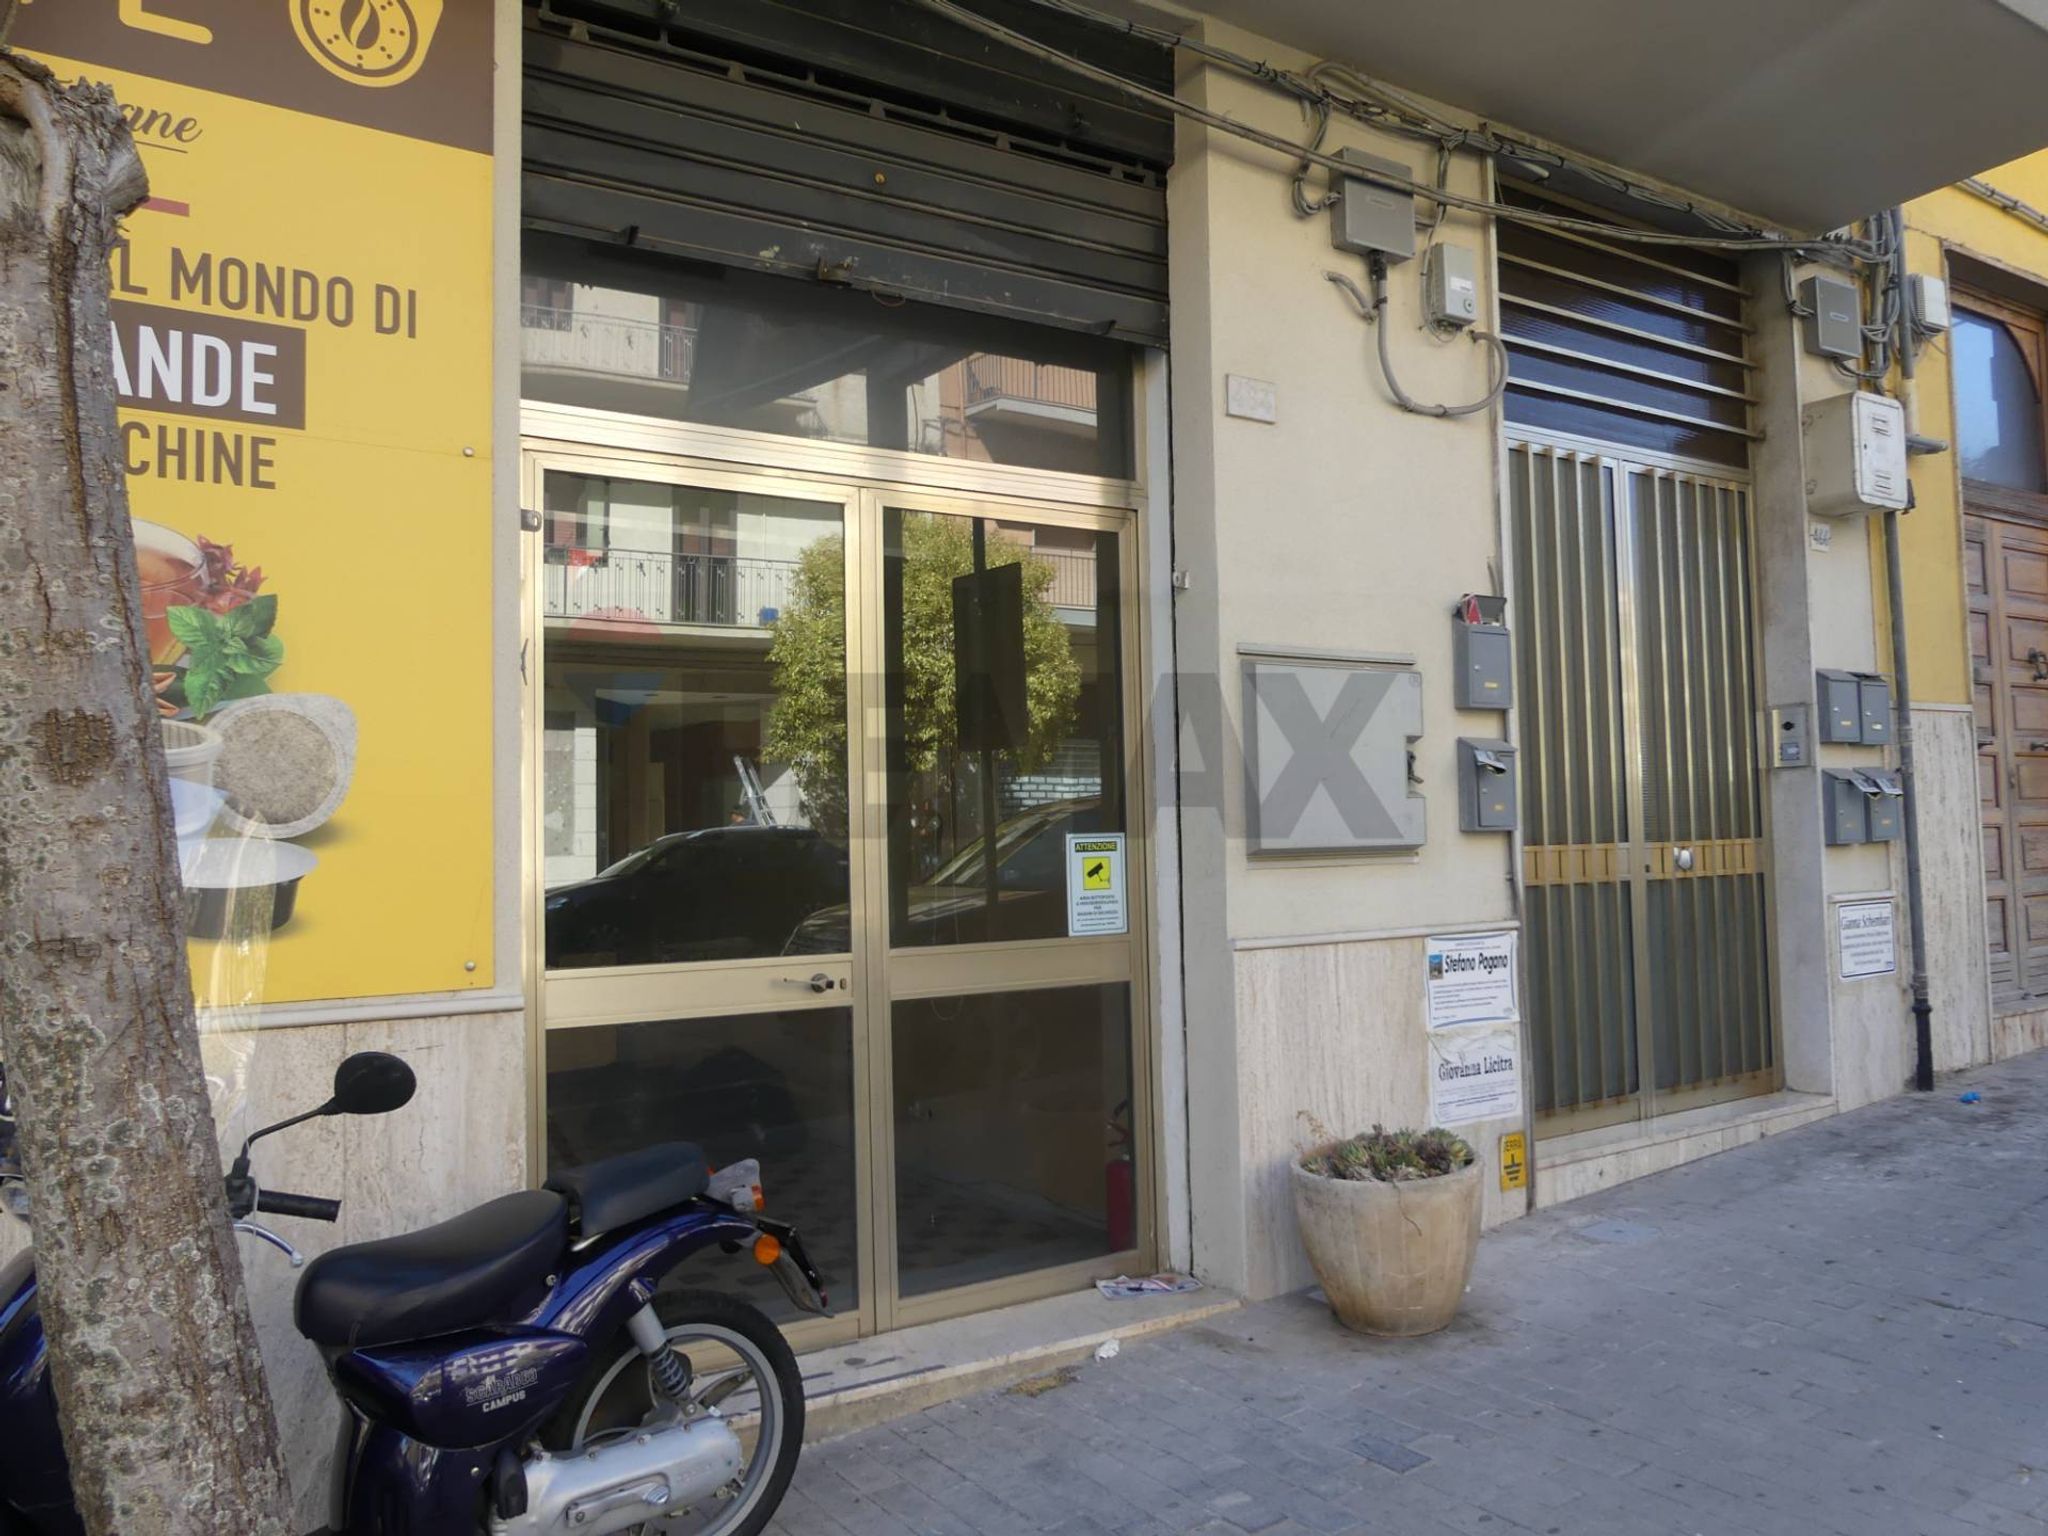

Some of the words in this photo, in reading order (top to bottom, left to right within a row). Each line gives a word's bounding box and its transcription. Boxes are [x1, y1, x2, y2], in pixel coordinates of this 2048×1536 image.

[118, 104, 203, 143] ane
[170, 246, 354, 328] MONDO
[375, 283, 416, 339] DI
[111, 320, 278, 415] ANDE
[119, 421, 276, 490] CHINE
[1075, 841, 1117, 852] ATTENZIONE
[1444, 952, 1476, 974] Stefano
[1478, 952, 1508, 975] Pagano
[1437, 1061, 1482, 1082] Giovanna
[1483, 1053, 1514, 1074] Licitra
[482, 1390, 526, 1413] CAMPUS
